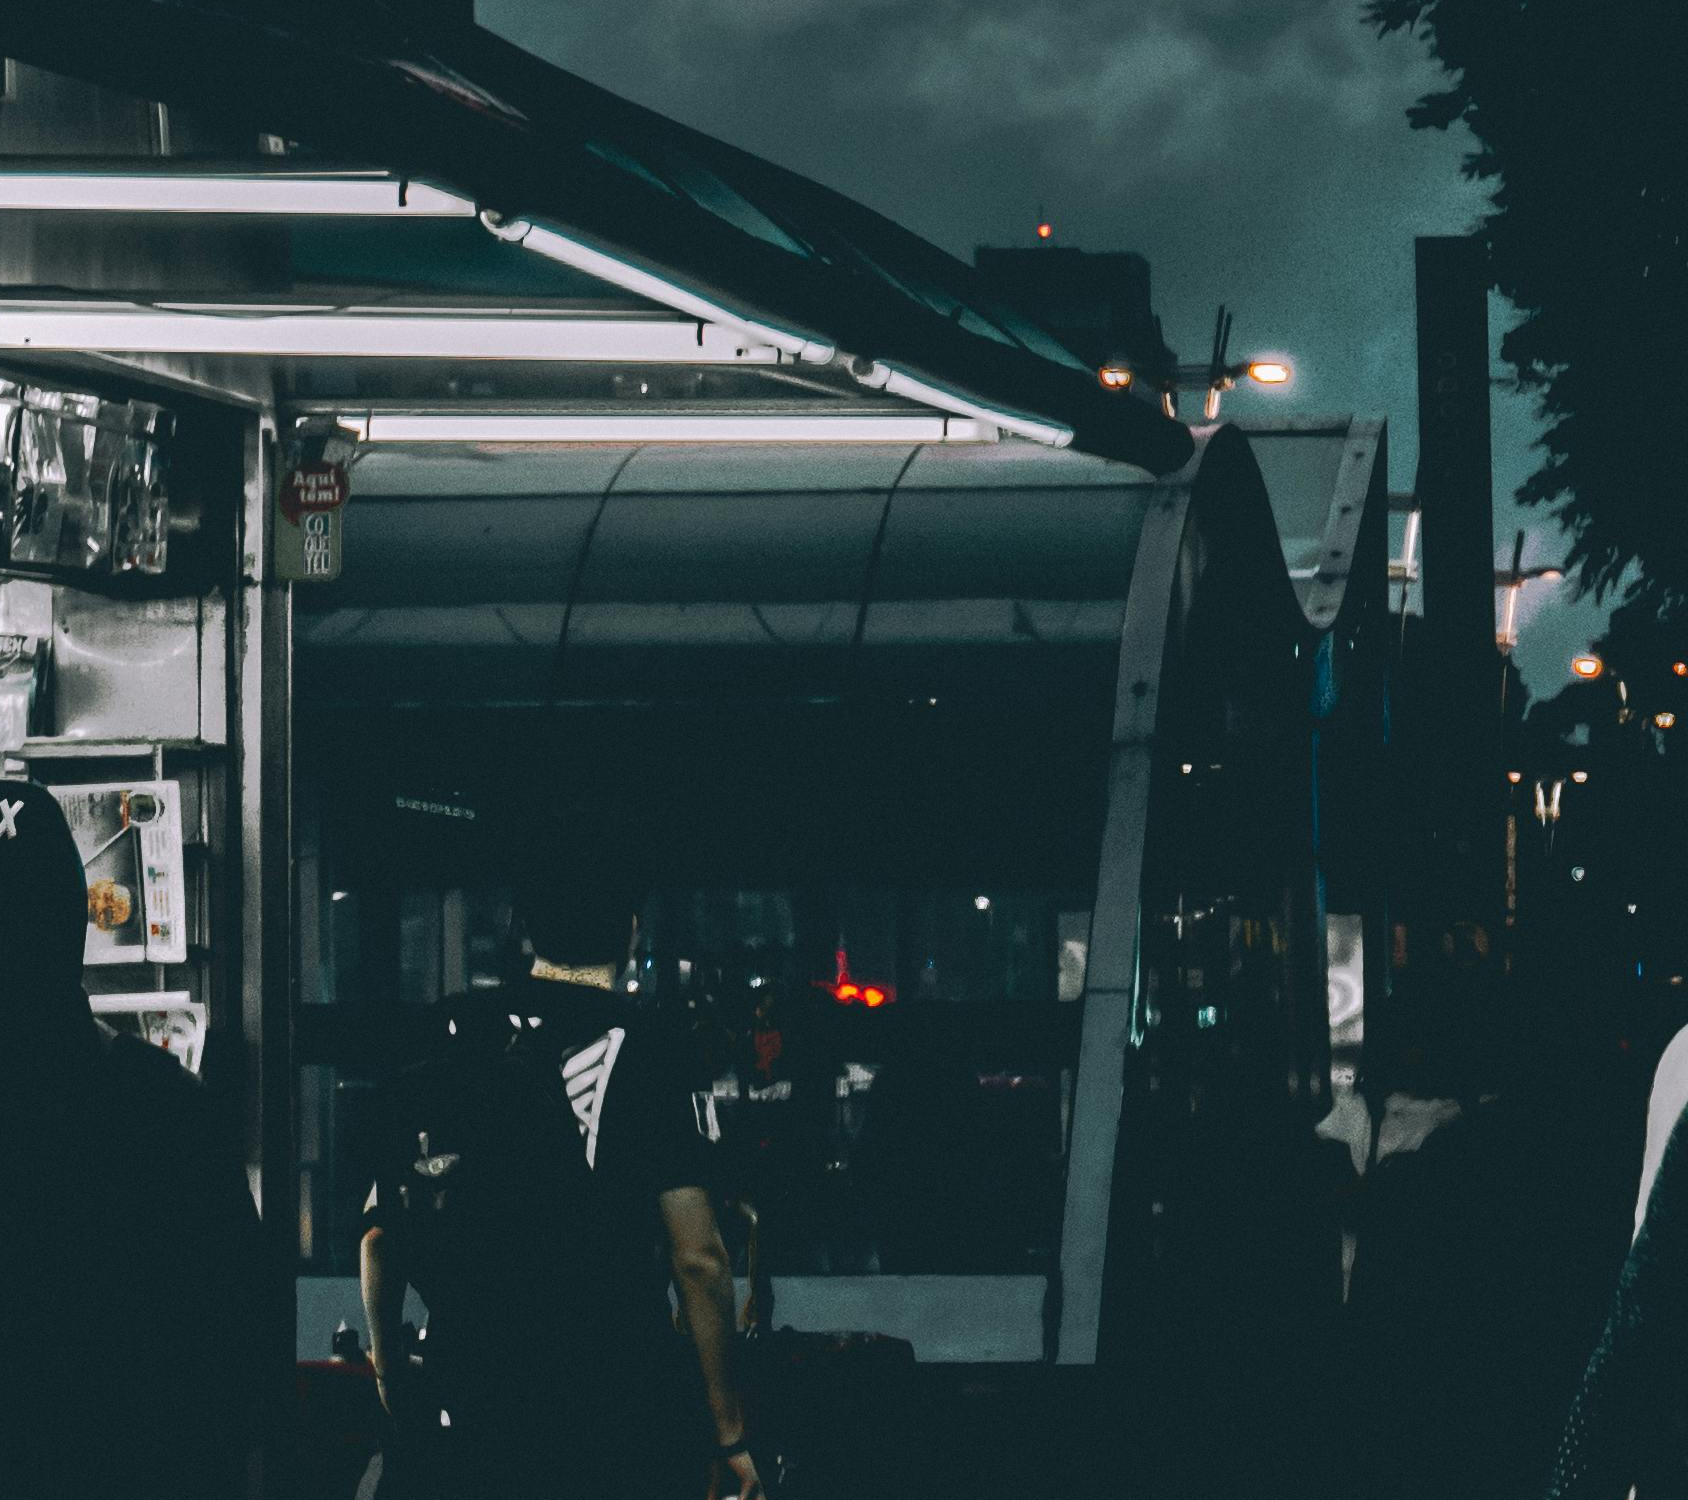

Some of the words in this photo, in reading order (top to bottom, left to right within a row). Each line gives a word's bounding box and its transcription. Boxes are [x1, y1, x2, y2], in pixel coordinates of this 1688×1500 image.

[293, 468, 336, 490] Aqui
[300, 484, 340, 503] tem!
[306, 513, 324, 536] CO
